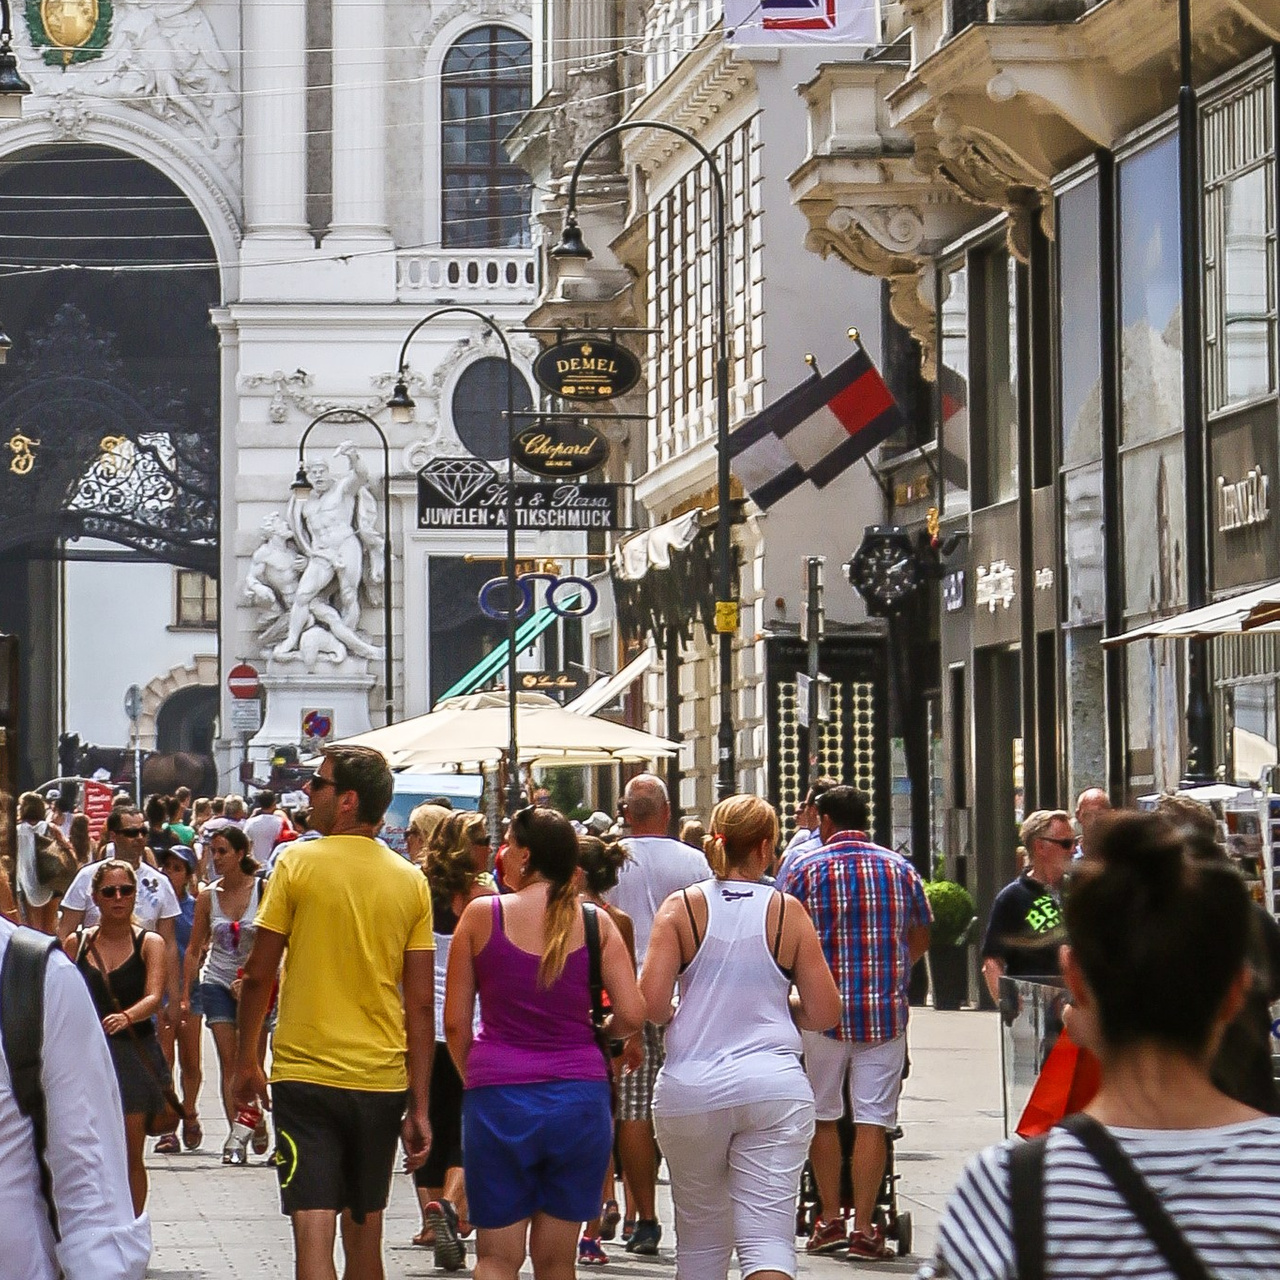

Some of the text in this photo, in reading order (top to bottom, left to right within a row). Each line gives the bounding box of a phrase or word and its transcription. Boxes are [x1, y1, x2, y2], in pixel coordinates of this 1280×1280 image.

[556, 357, 618, 374] DEMEL
[520, 434, 598, 459] Chopard
[528, 493, 545, 506] &
